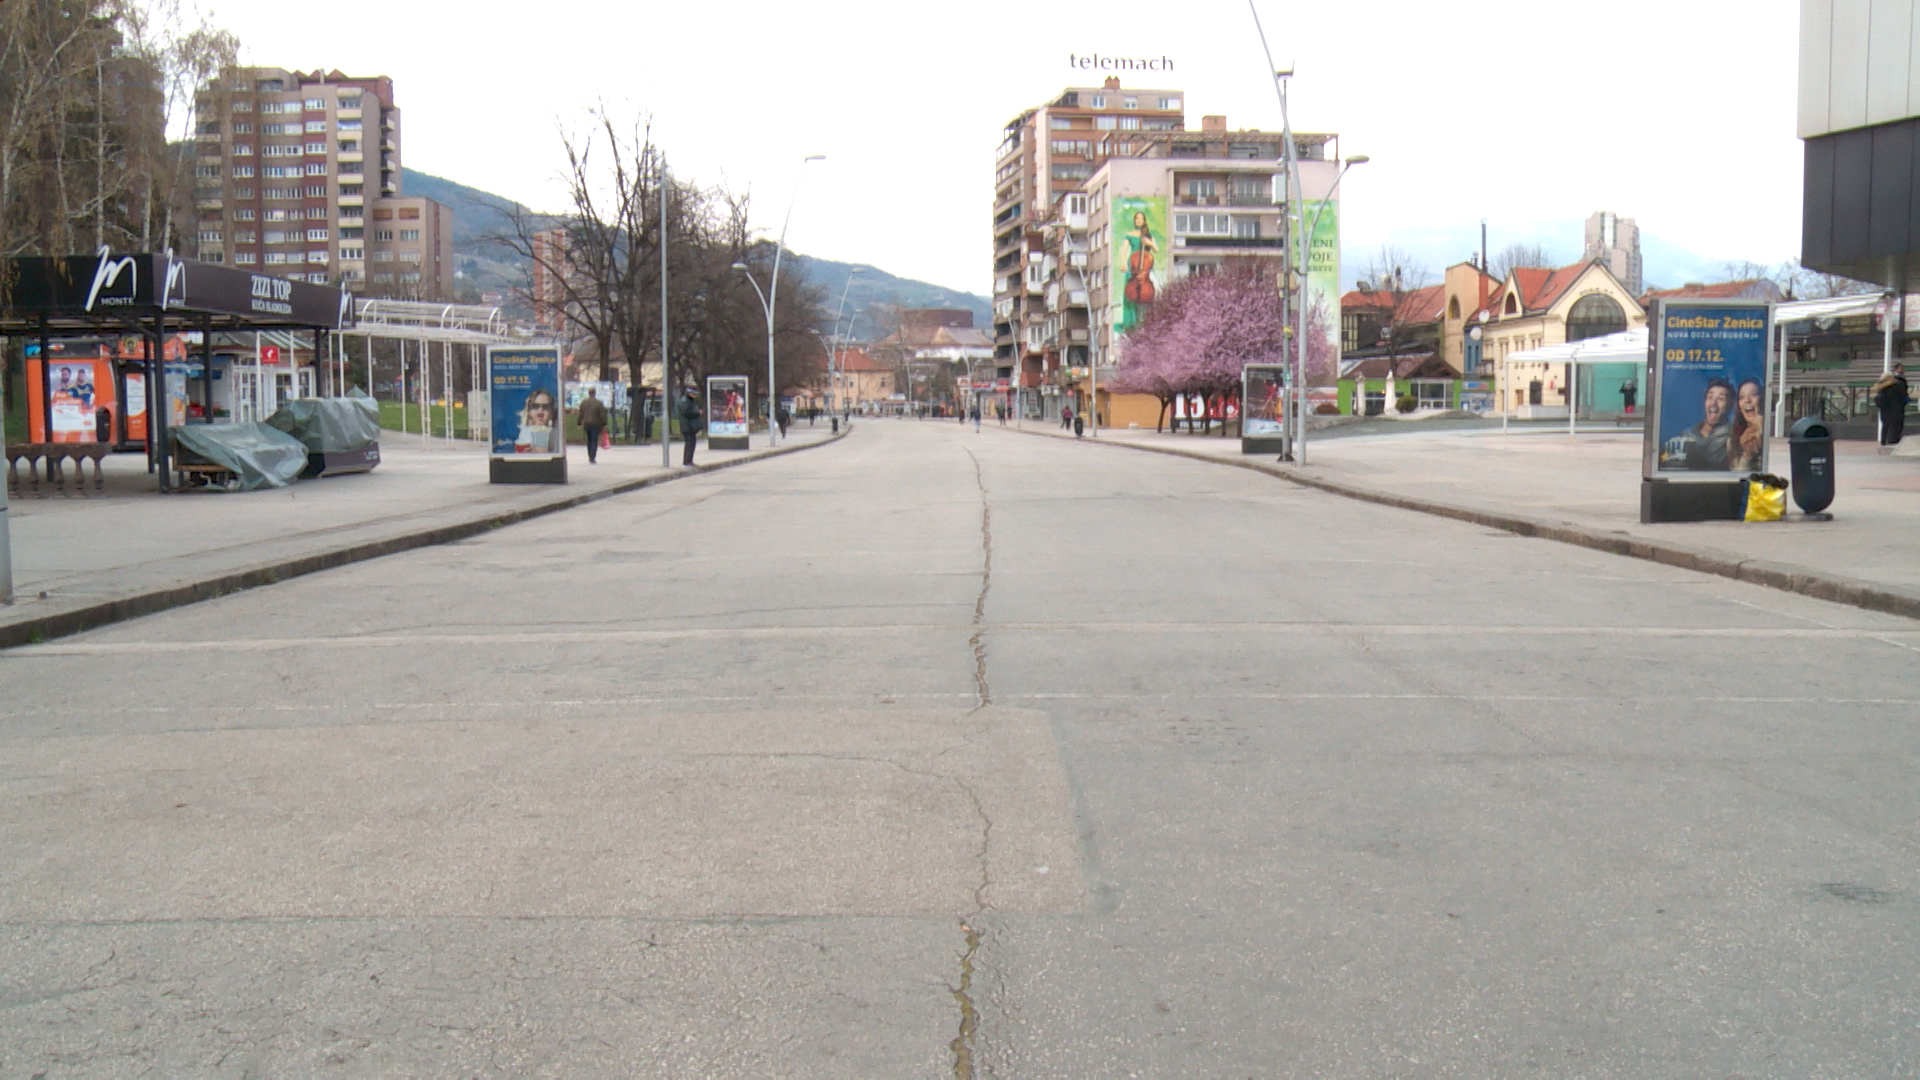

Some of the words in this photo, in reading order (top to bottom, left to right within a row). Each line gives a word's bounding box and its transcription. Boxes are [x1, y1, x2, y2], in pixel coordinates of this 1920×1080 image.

[1070, 53, 1173, 70] telemach
[251, 275, 271, 298] ZIZI
[271, 278, 291, 301] TOP
[1667, 315, 1720, 328] CineStar
[1723, 315, 1763, 328] Zenica
[1666, 349, 1686, 362] OD
[1688, 349, 1724, 362] 17.12.
